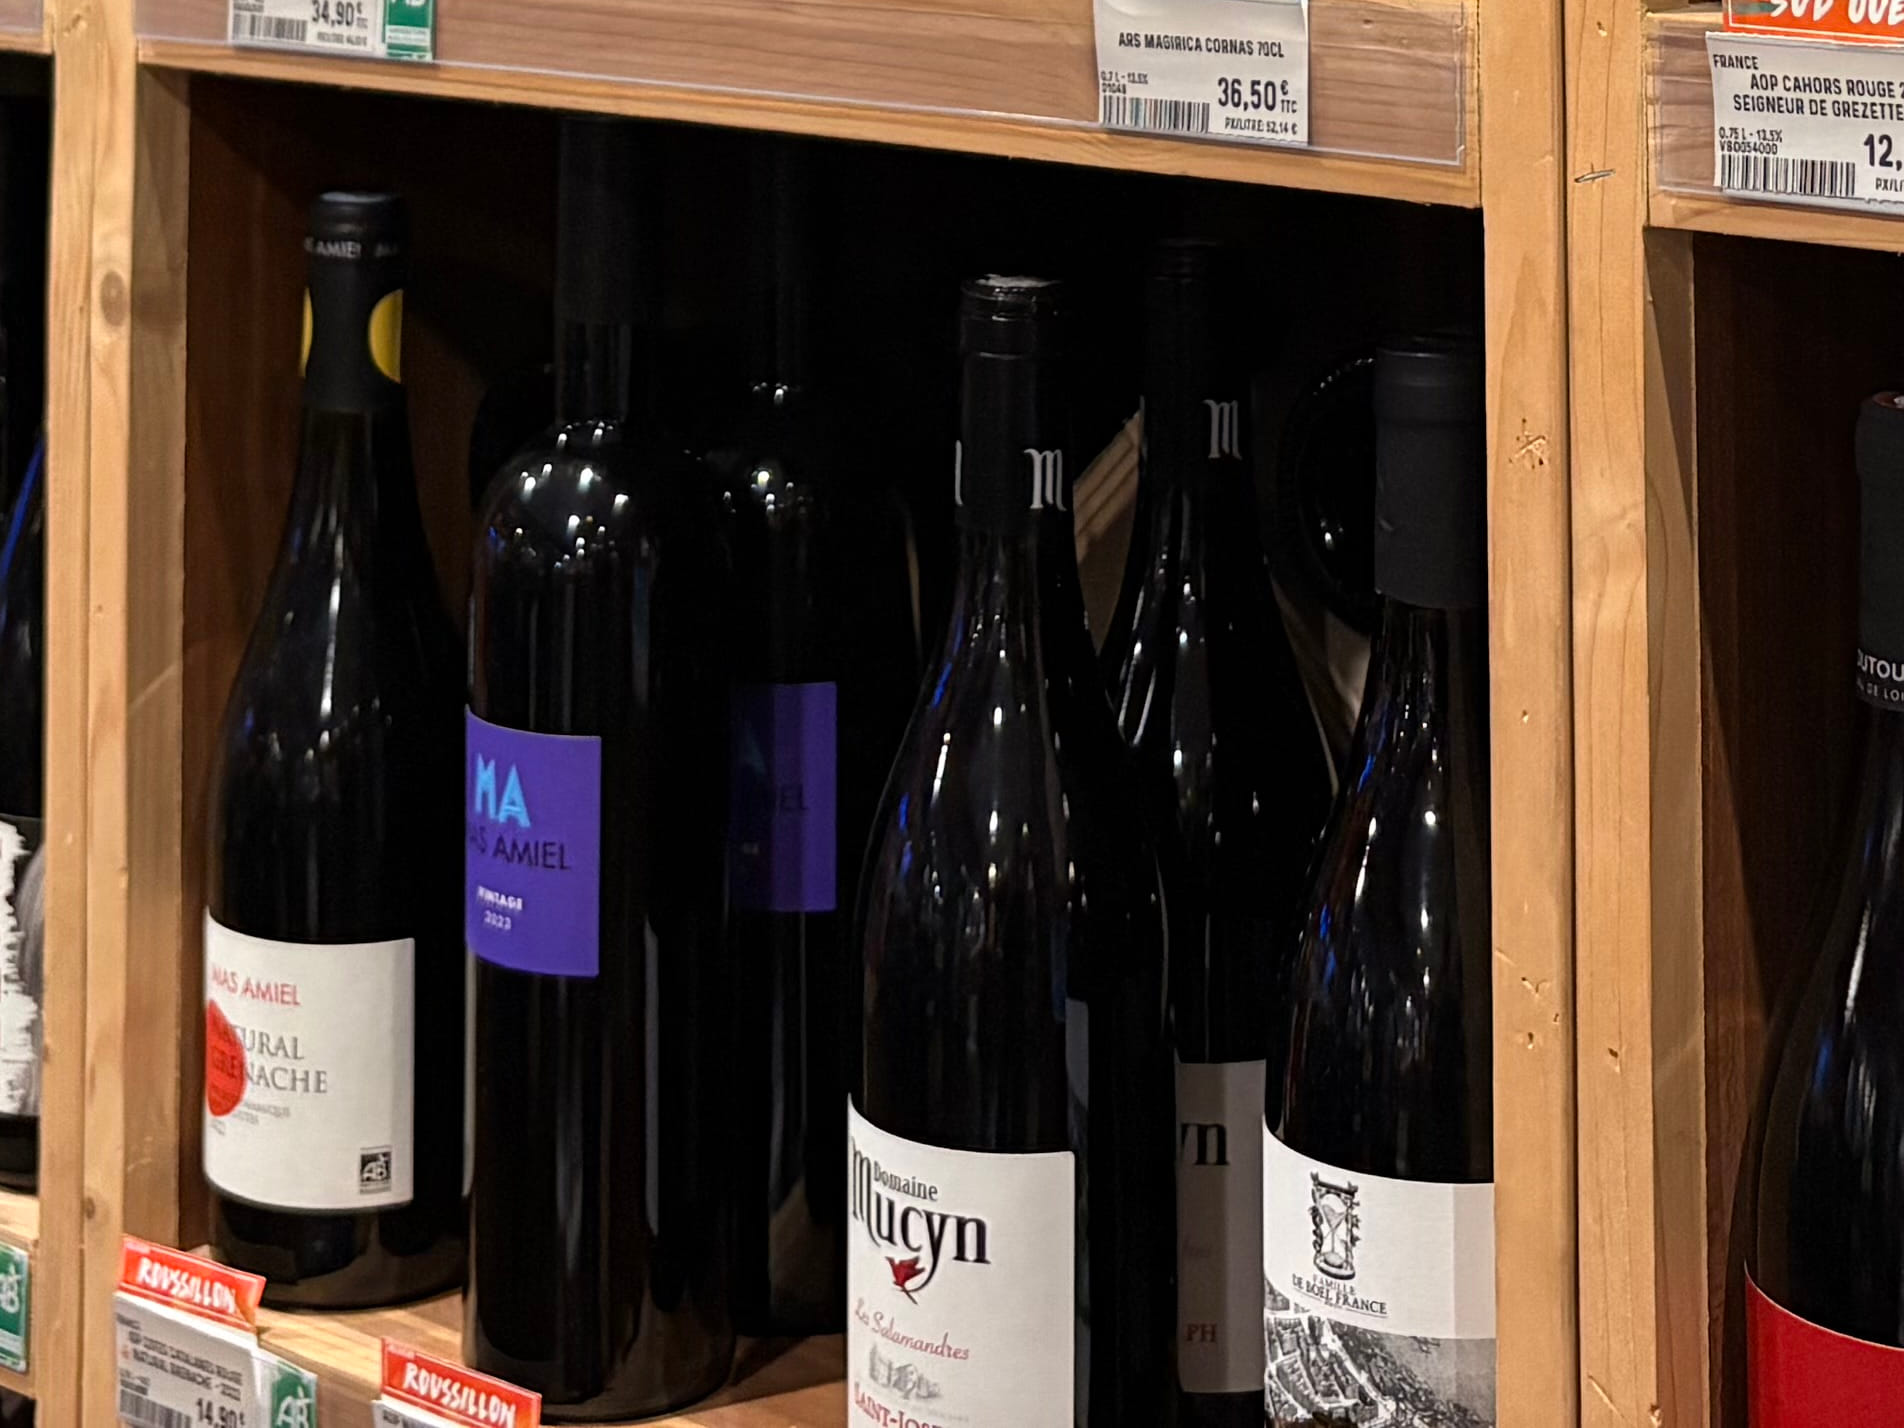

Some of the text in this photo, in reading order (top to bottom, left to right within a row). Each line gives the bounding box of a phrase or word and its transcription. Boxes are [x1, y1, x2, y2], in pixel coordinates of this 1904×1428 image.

[312, 0, 354, 28] 34,90
[1119, 32, 1284, 58] ARS MAGIRICA CORNAS 70CL
[1713, 54, 1759, 70] FRANCE
[1218, 77, 1276, 112] 36,50
[1750, 74, 1778, 90] AOP
[1783, 77, 1842, 96] CAHORS
[1846, 80, 1895, 99] ROUGE
[1280, 99, 1297, 113] TTC
[1733, 94, 1805, 115] SEIGNEUR
[1809, 99, 1828, 117] DE
[1832, 101, 1904, 121] GREZETTE
[475, 753, 530, 828] MA
[494, 840, 570, 871] AMIEL
[244, 977, 301, 1006] AMIEL
[873, 1159, 938, 1203] Domaine
[851, 1142, 991, 1294] Mucyn
[137, 1257, 237, 1313] ROUSSILLON
[1334, 1292, 1388, 1317] FRANCE
[872, 1311, 970, 1362] Salamandres
[403, 1362, 518, 1428] ROUSSILLON
